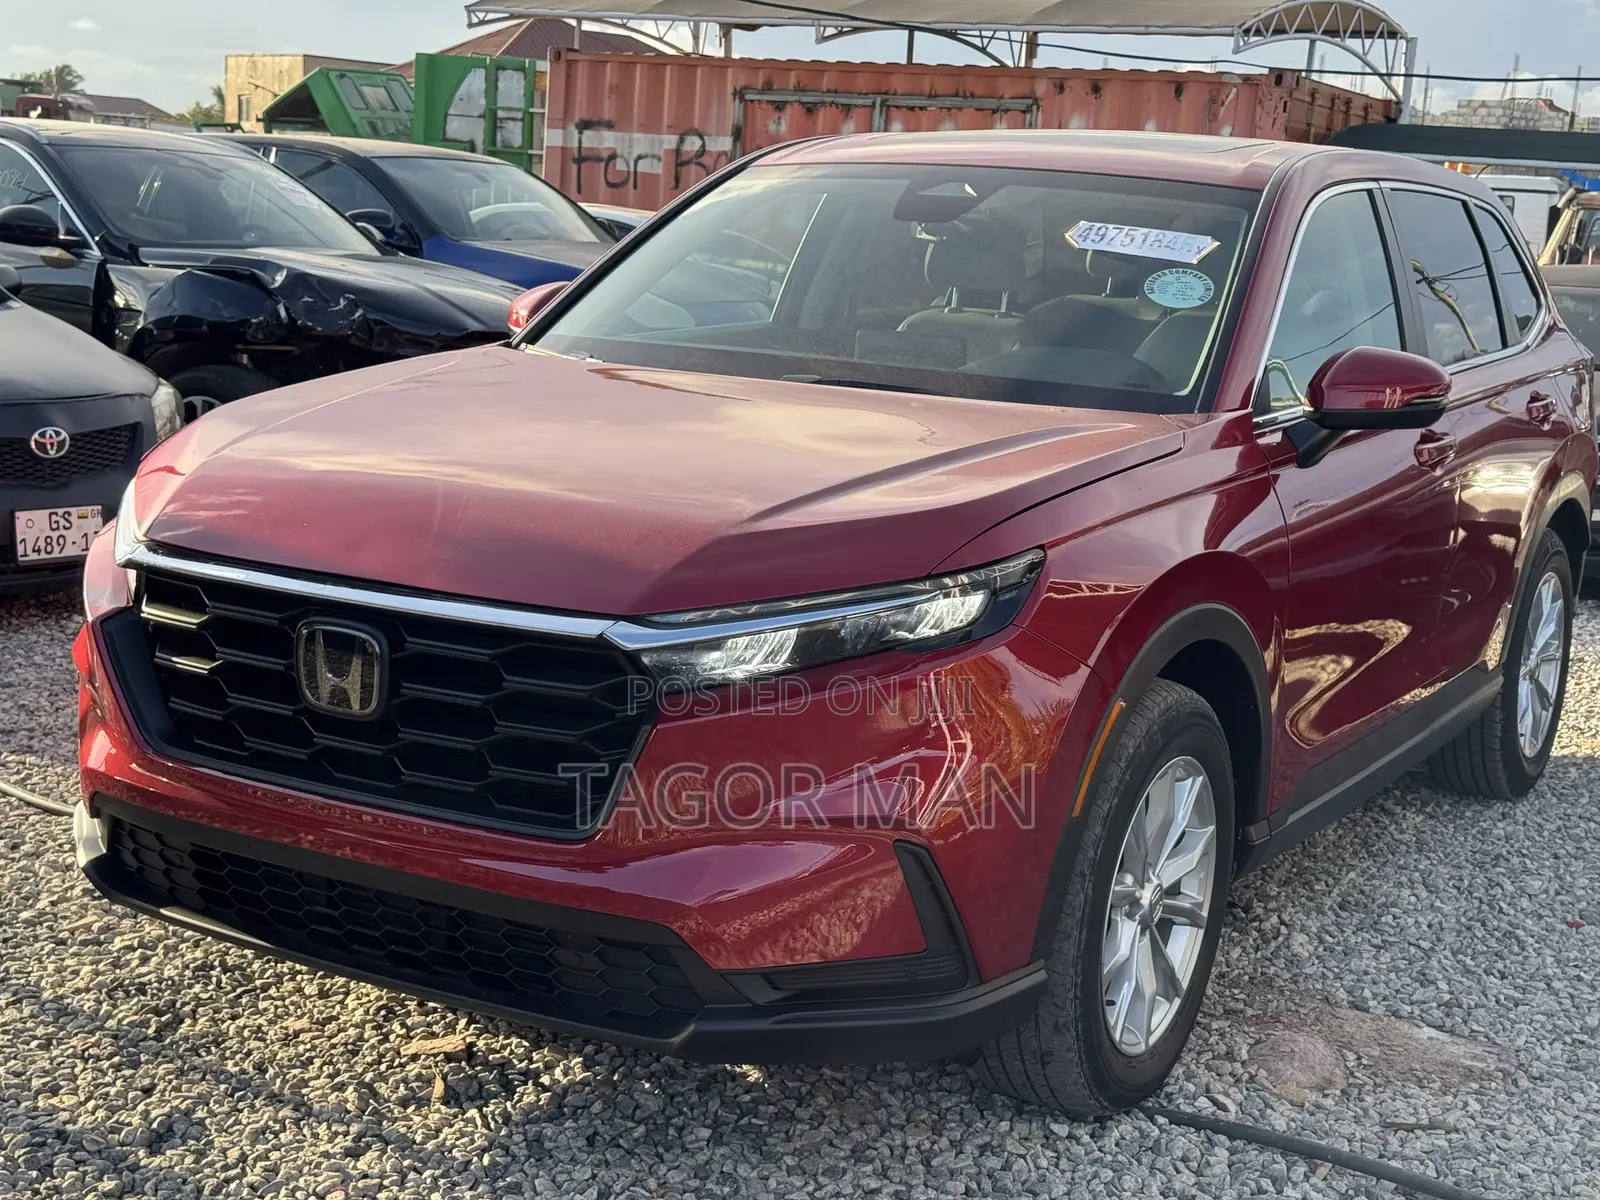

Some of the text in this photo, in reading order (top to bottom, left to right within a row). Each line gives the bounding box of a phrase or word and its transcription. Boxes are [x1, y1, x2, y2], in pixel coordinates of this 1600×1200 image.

[572, 118, 662, 195] For
[1168, 269, 1208, 283] COMPANY
[48, 510, 73, 532] GS
[19, 530, 99, 558] 1489-1
